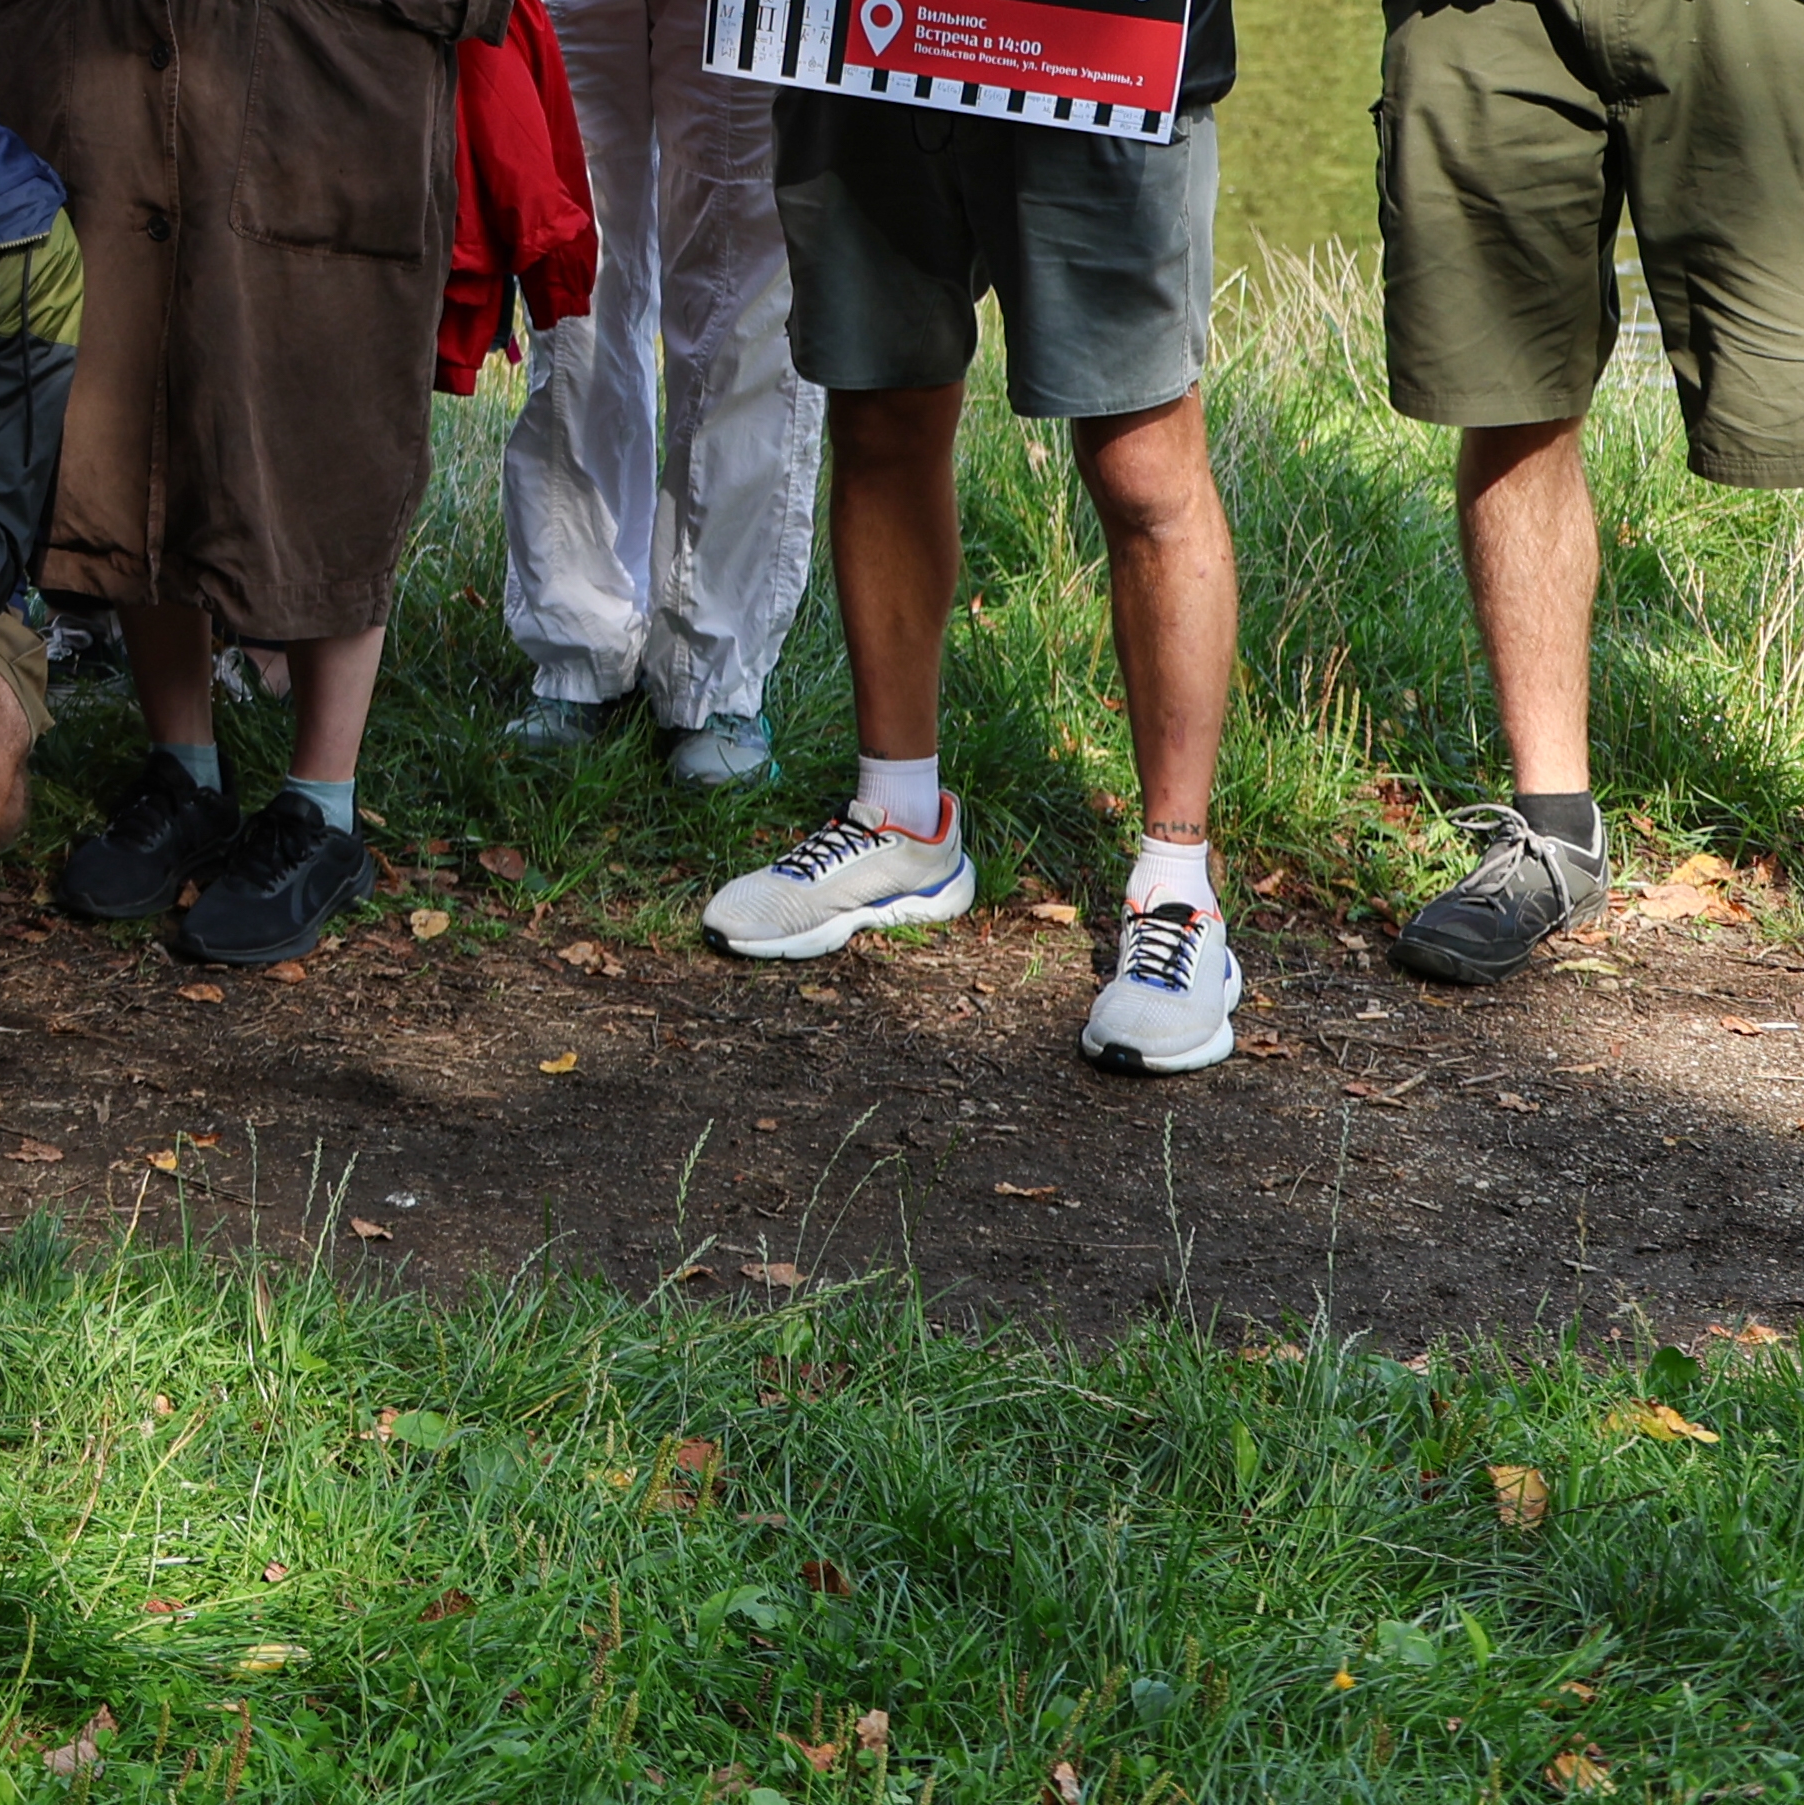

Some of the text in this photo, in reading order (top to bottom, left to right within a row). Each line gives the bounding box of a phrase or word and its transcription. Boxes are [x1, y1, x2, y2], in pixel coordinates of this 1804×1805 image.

[916, 5, 987, 29] Вильнюс
[914, 23, 1042, 56] Встреча в 14:00
[912, 42, 1144, 87] Посольство России, ул. Героев Украины, 2
